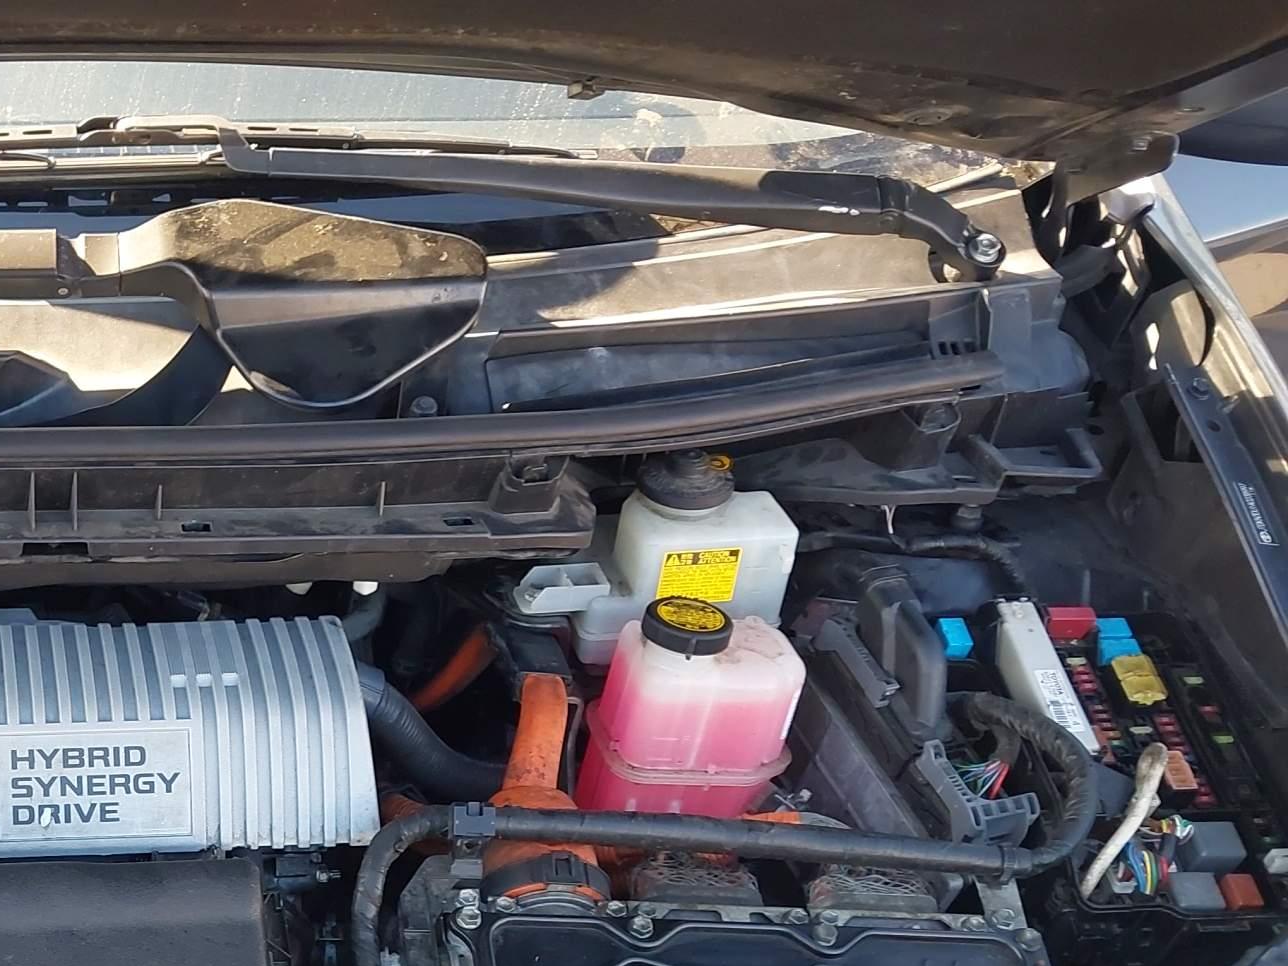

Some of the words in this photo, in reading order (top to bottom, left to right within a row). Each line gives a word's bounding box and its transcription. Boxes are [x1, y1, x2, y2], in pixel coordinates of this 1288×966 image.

[11, 746, 146, 770] HYBRID
[11, 772, 181, 798] SYNERGY
[12, 802, 120, 825] DRIVE
